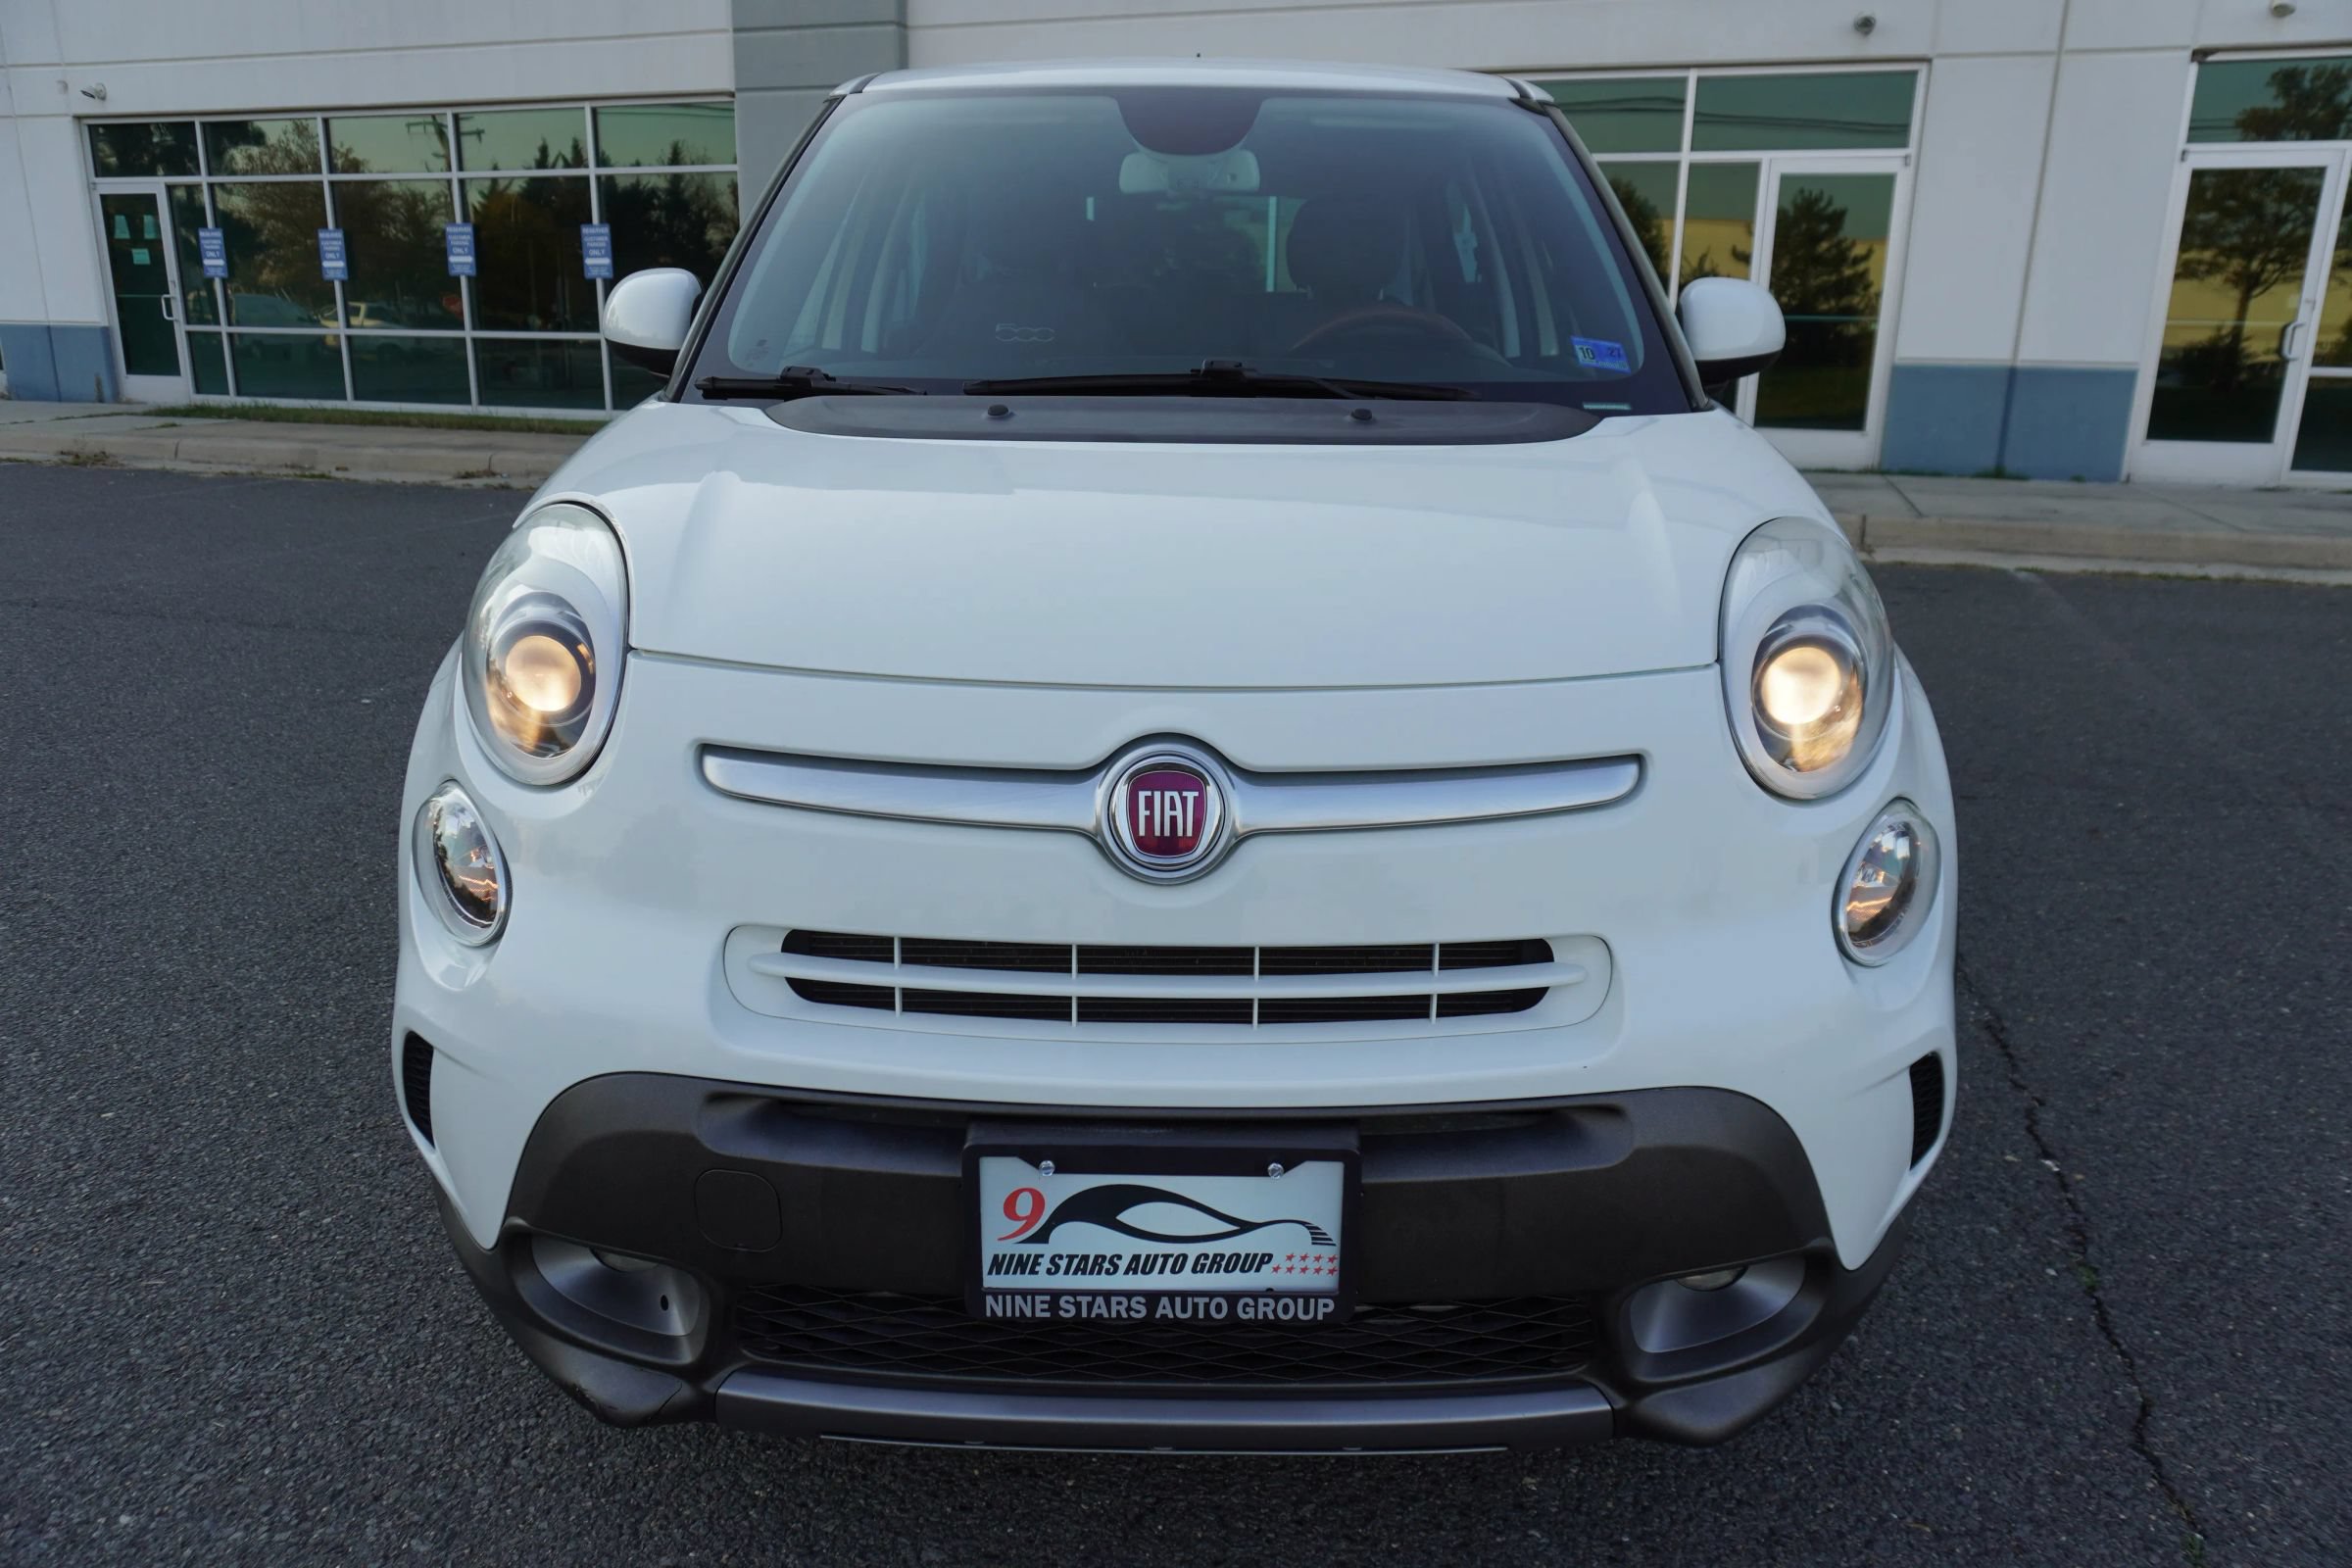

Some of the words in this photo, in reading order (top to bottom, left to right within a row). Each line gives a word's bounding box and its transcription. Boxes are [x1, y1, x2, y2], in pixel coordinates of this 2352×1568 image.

[1579, 347, 1595, 360] 10
[1138, 790, 1200, 837] FIAT
[997, 1187, 1046, 1242] 9
[987, 1253, 1045, 1276] NINE
[1046, 1253, 1122, 1276] STARS
[1123, 1253, 1189, 1276] AUTO
[1191, 1252, 1274, 1275] GROUP
[985, 1295, 1052, 1318] NINE
[1058, 1296, 1148, 1319] STARS
[1154, 1297, 1229, 1320] AUTO
[1236, 1298, 1335, 1321] GROUP
